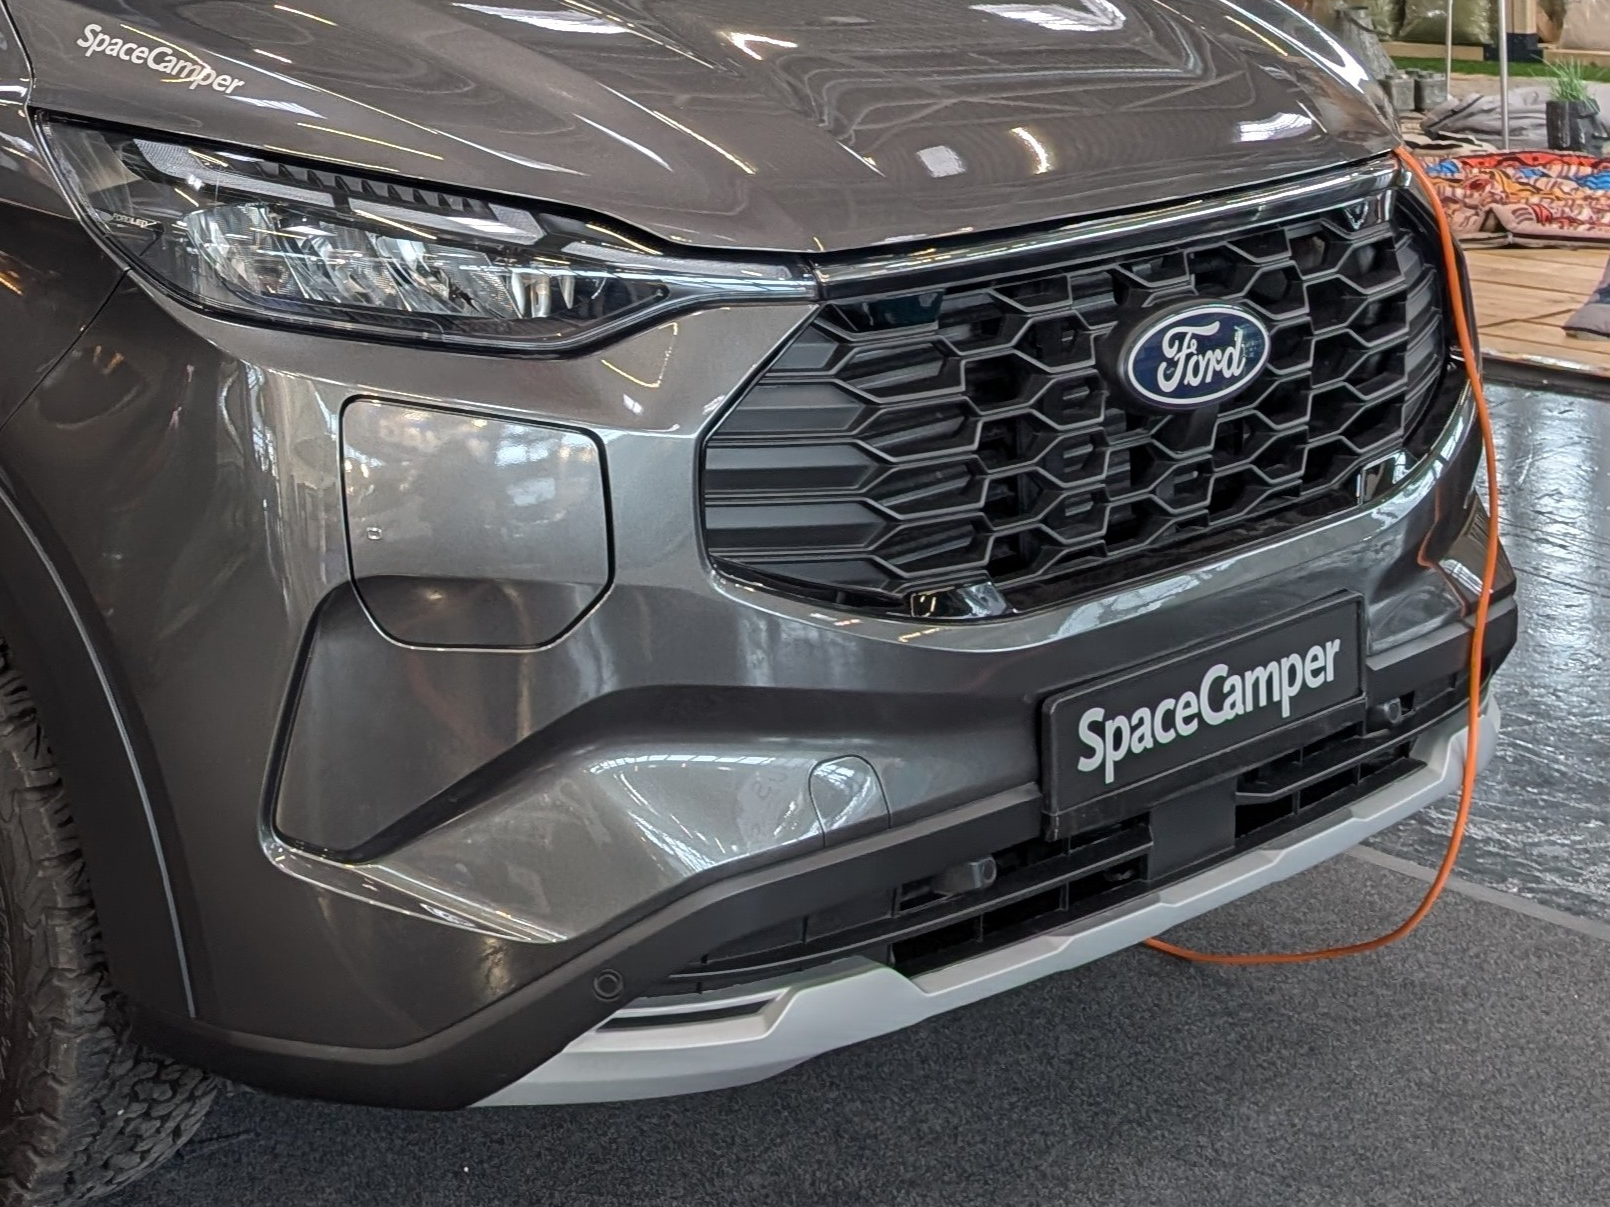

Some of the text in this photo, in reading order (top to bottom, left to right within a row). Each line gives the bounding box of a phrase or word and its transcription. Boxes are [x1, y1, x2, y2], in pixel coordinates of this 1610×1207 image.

[77, 24, 245, 94] SpaceCamper
[1157, 320, 1246, 392] Ford
[1077, 638, 1340, 784] SpaceCamper
